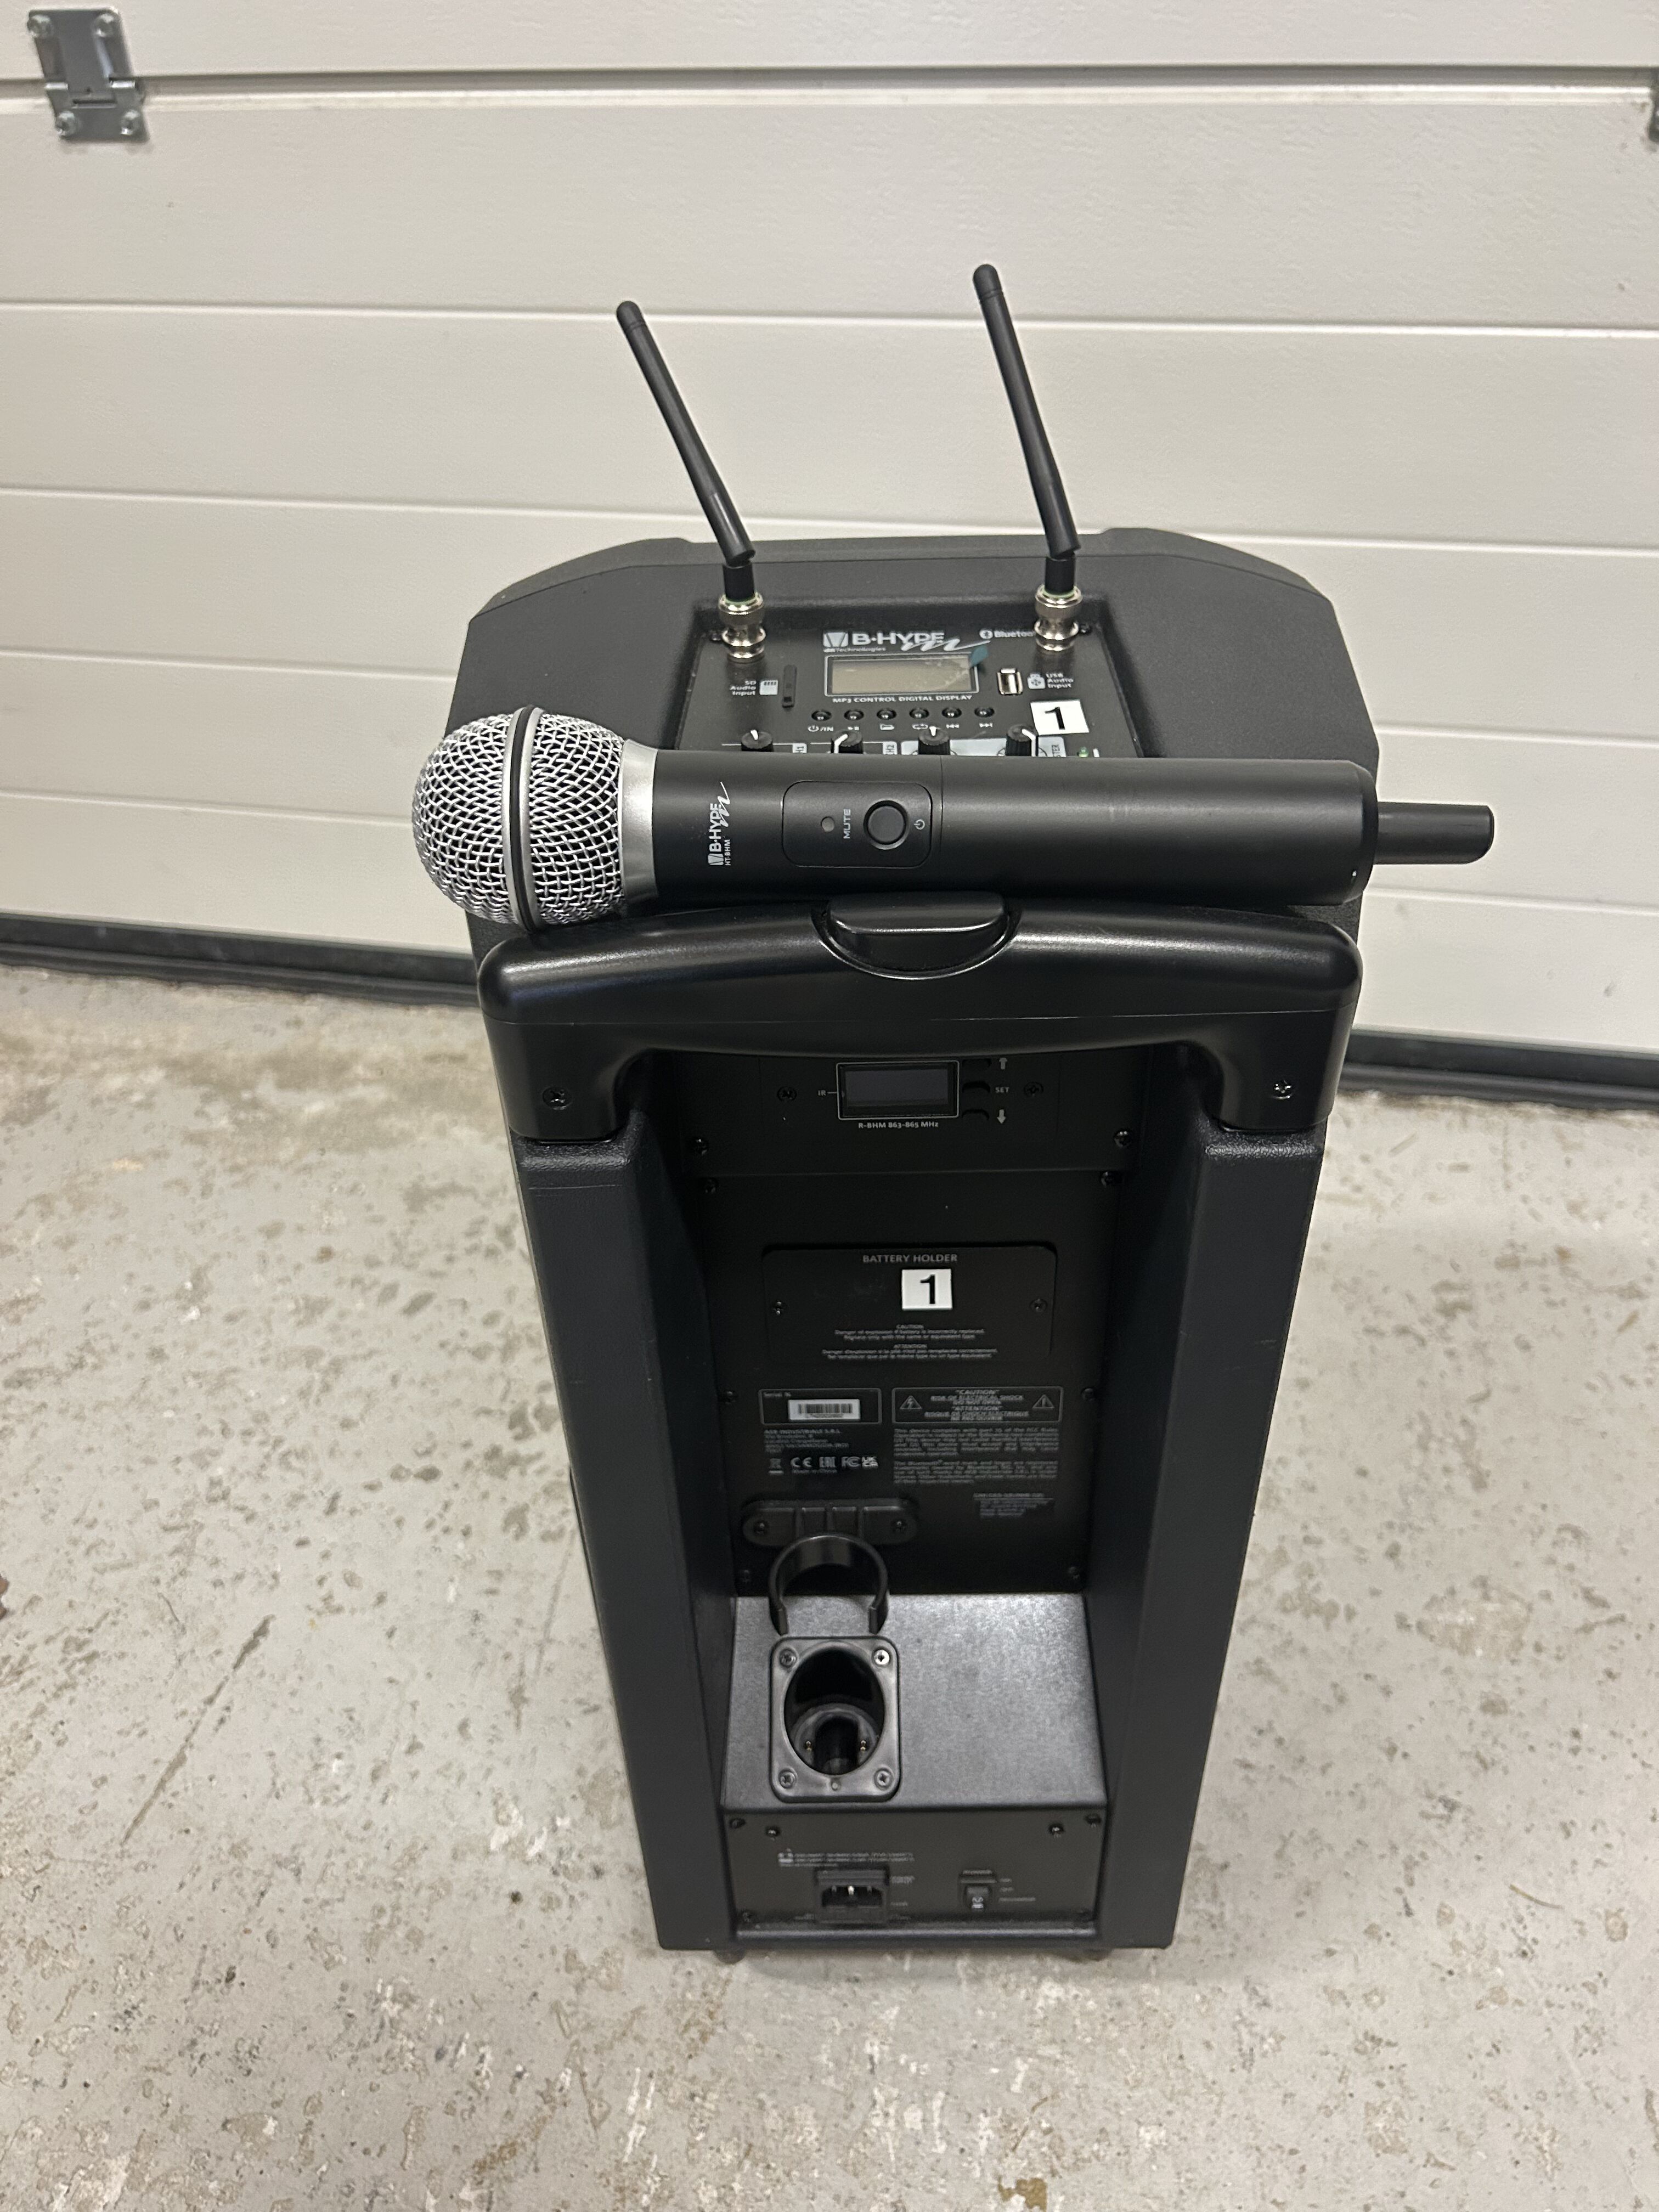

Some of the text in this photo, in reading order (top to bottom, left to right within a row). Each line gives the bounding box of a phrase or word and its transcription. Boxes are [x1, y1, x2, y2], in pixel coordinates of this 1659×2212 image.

[994, 629, 1036, 638] Bluetoo
[1045, 706, 1065, 730] 1
[885, 744, 895, 755] H2
[862, 1254, 957, 1263] BATTERY HOLDER
[920, 1274, 935, 1304] 1
